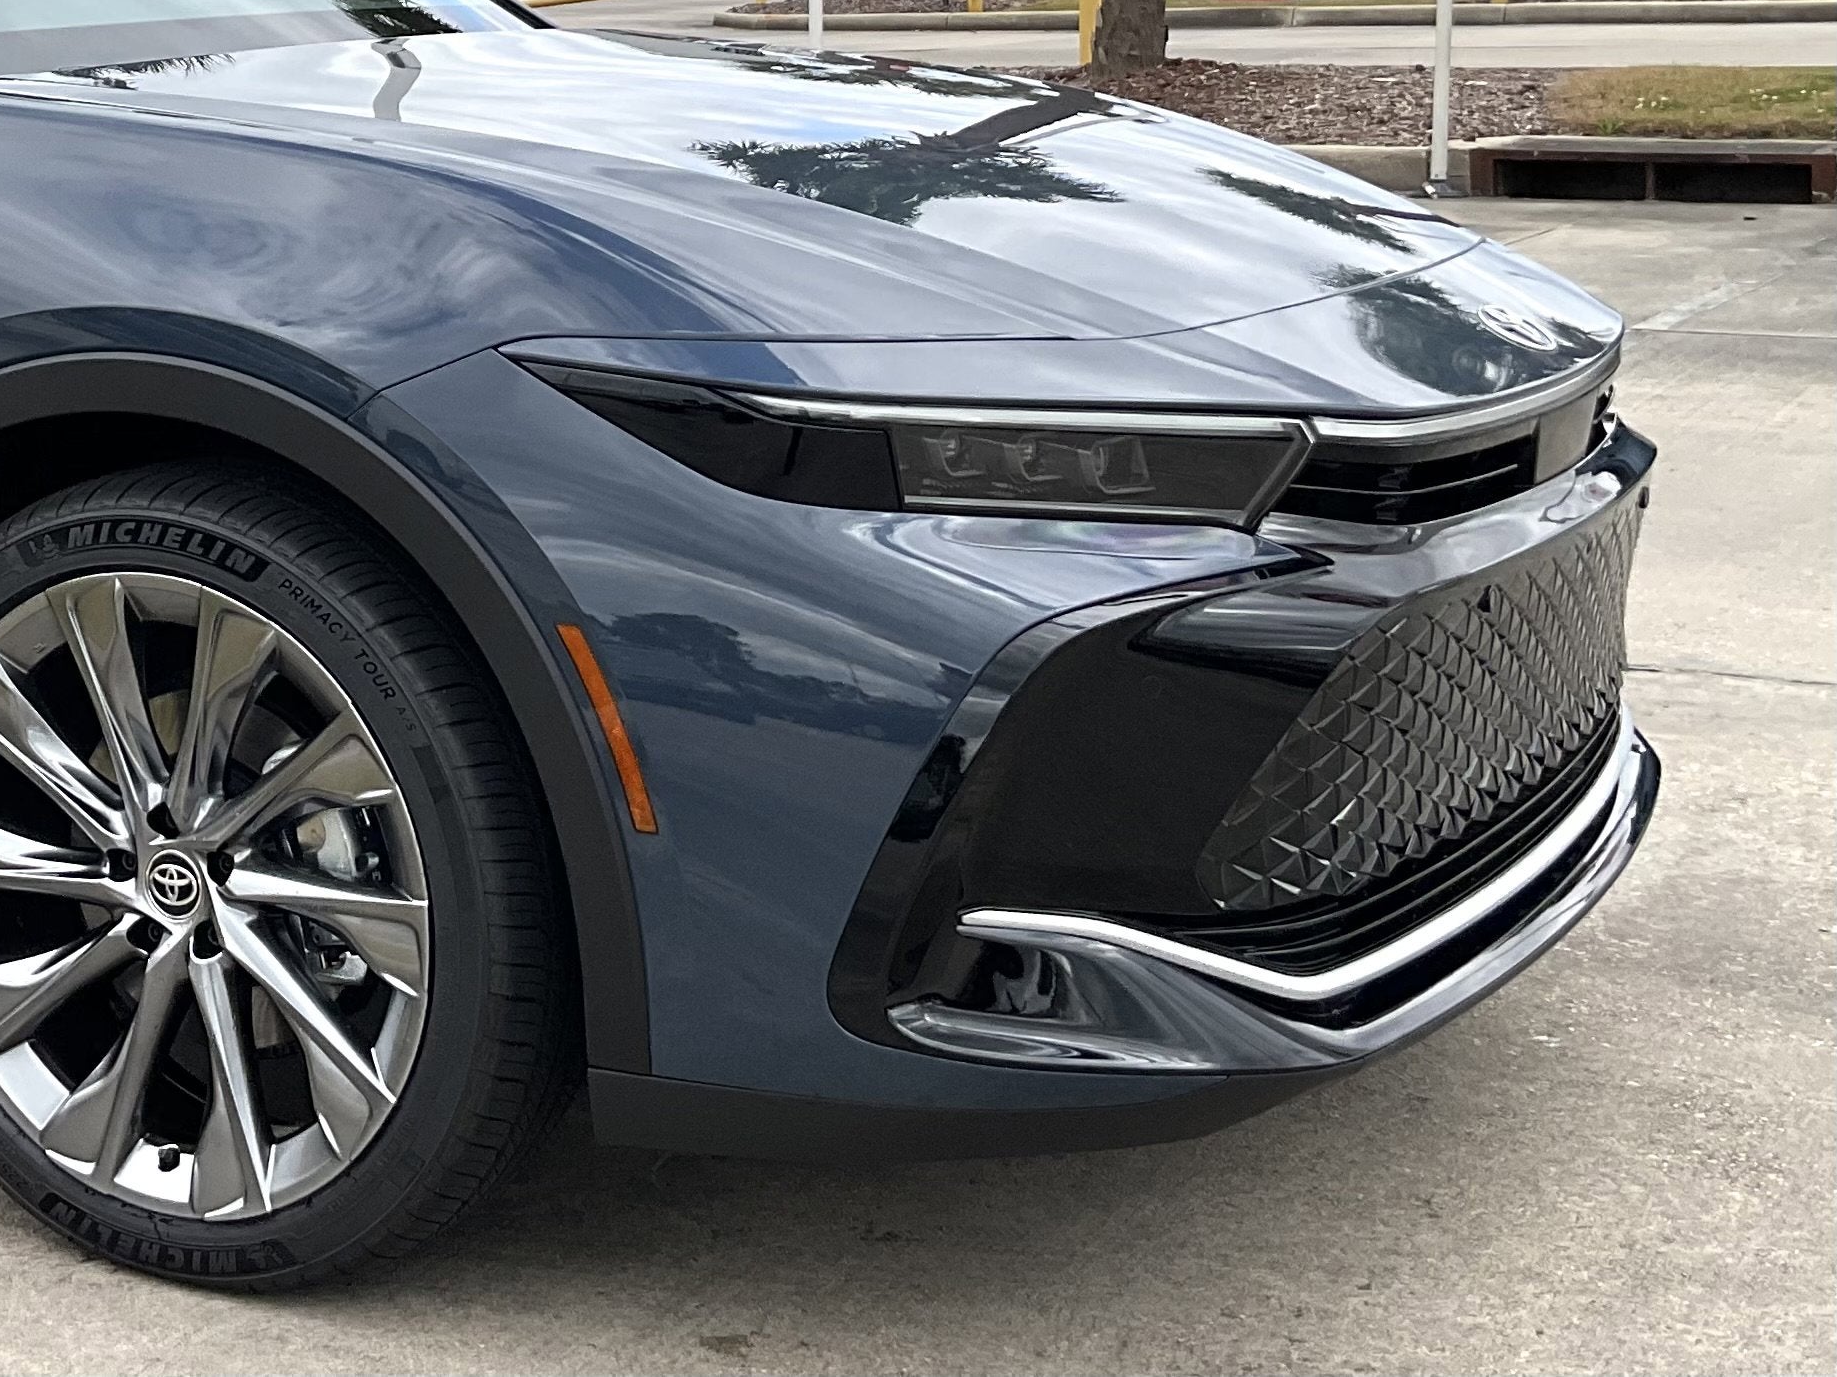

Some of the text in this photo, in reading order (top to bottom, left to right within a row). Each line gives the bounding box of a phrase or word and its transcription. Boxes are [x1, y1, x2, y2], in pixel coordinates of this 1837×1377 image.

[67, 521, 256, 574] MICHELIN
[278, 578, 356, 643] PRIMACY
[354, 648, 397, 700] TOUR
[49, 1202, 237, 1273] MICHELIN
